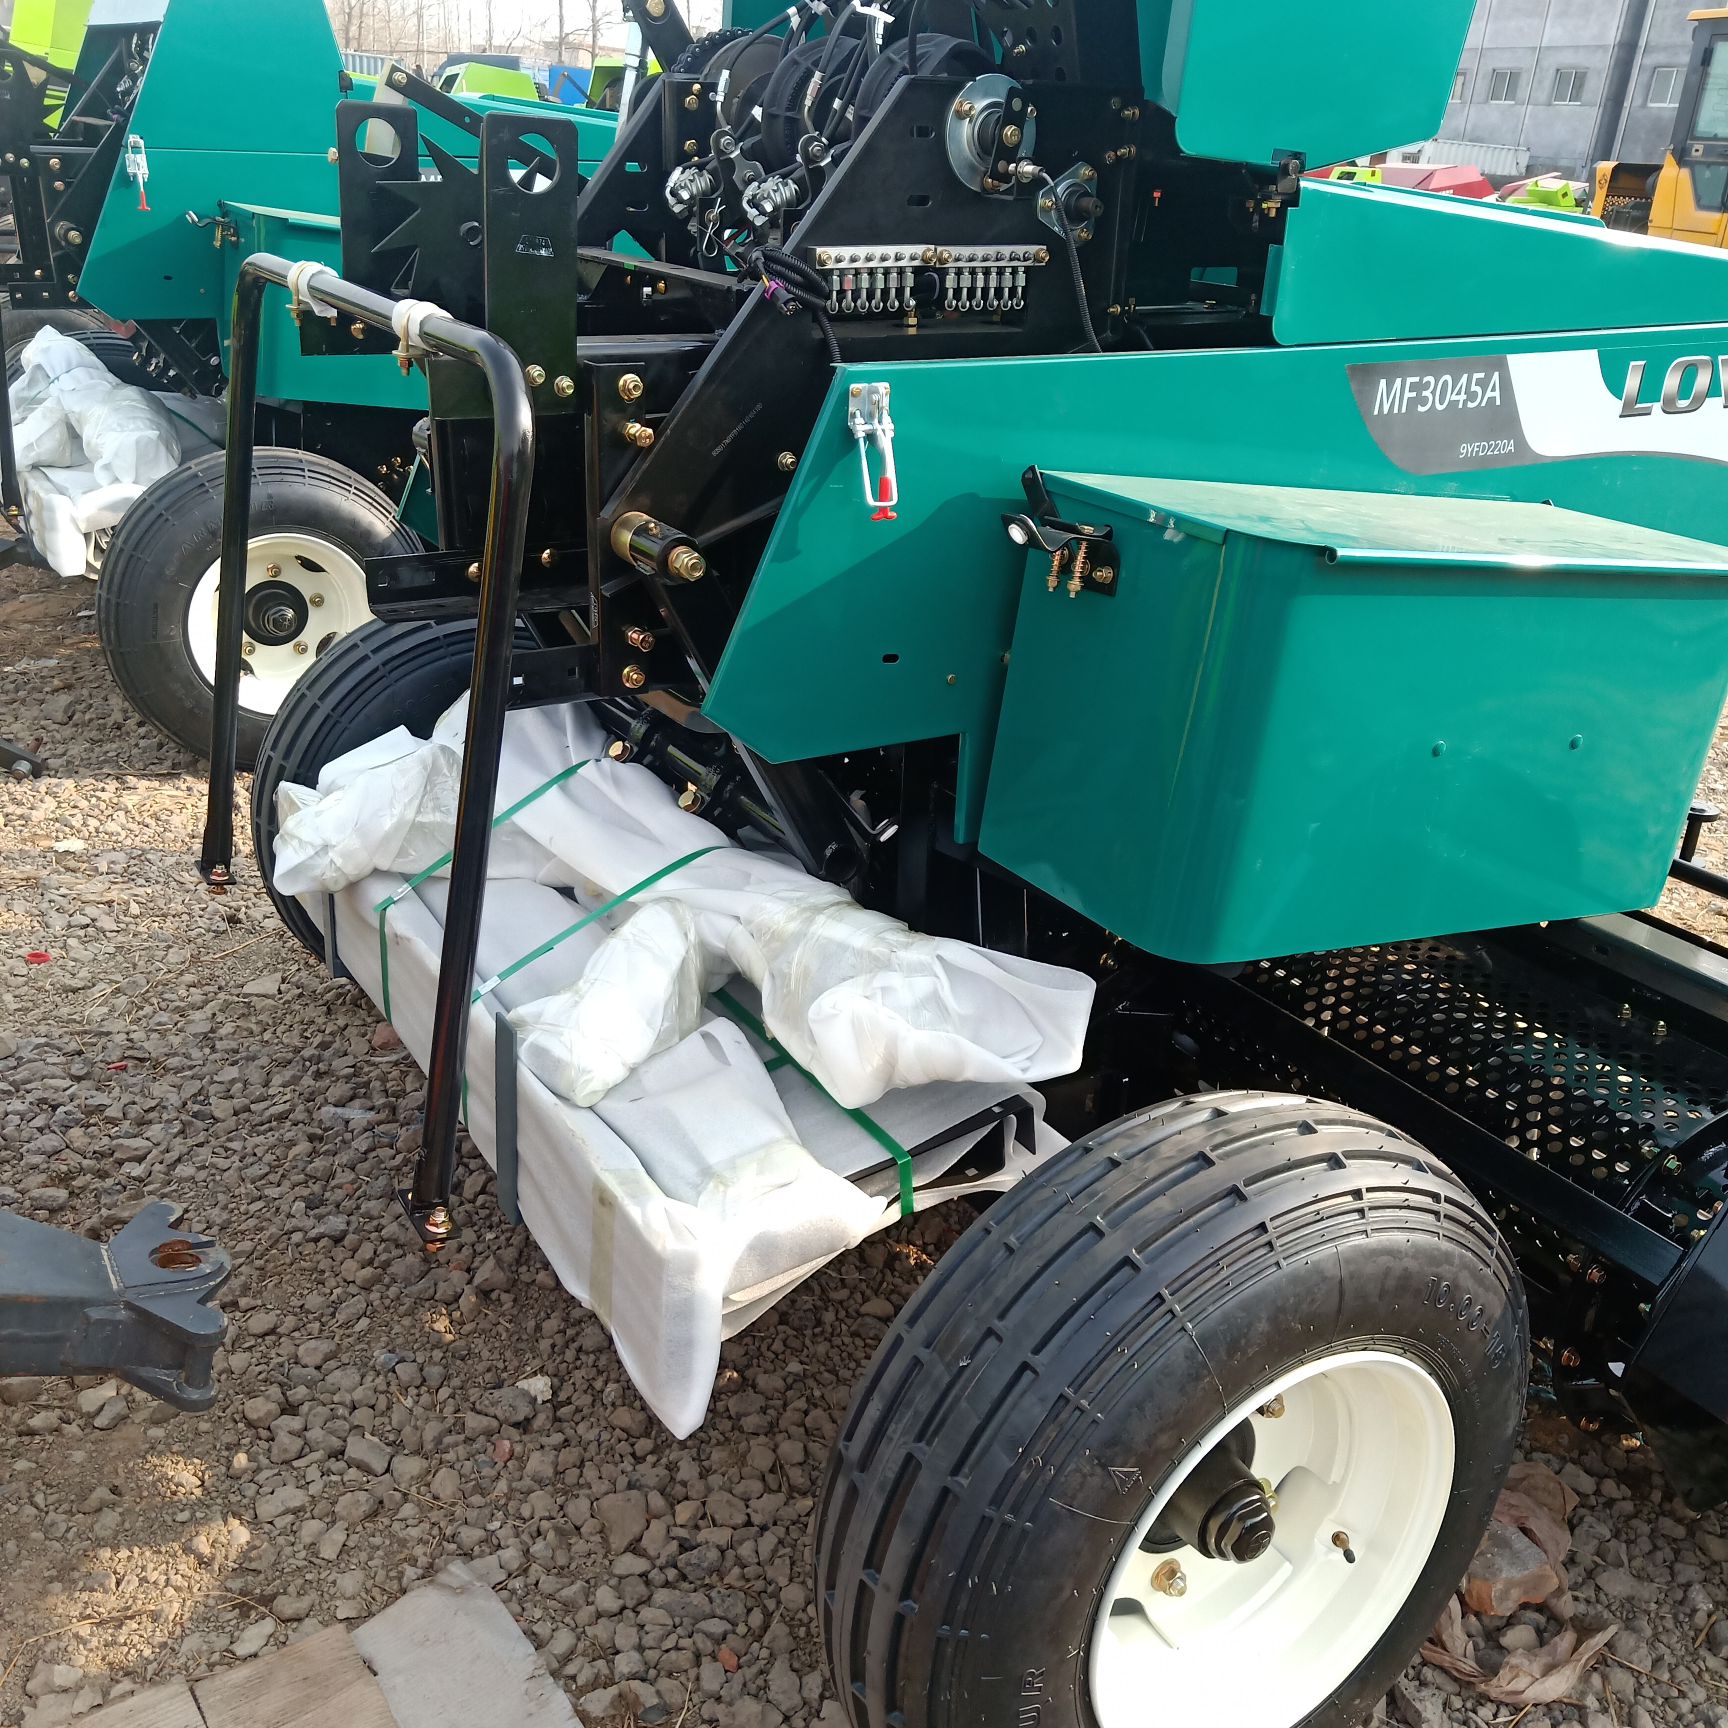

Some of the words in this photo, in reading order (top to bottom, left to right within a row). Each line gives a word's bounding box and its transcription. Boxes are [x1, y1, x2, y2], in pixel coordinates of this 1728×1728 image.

[1373, 371, 1501, 415] MF3045A
[1619, 354, 1728, 418] LO
[1459, 439, 1515, 458] 9YFD220A
